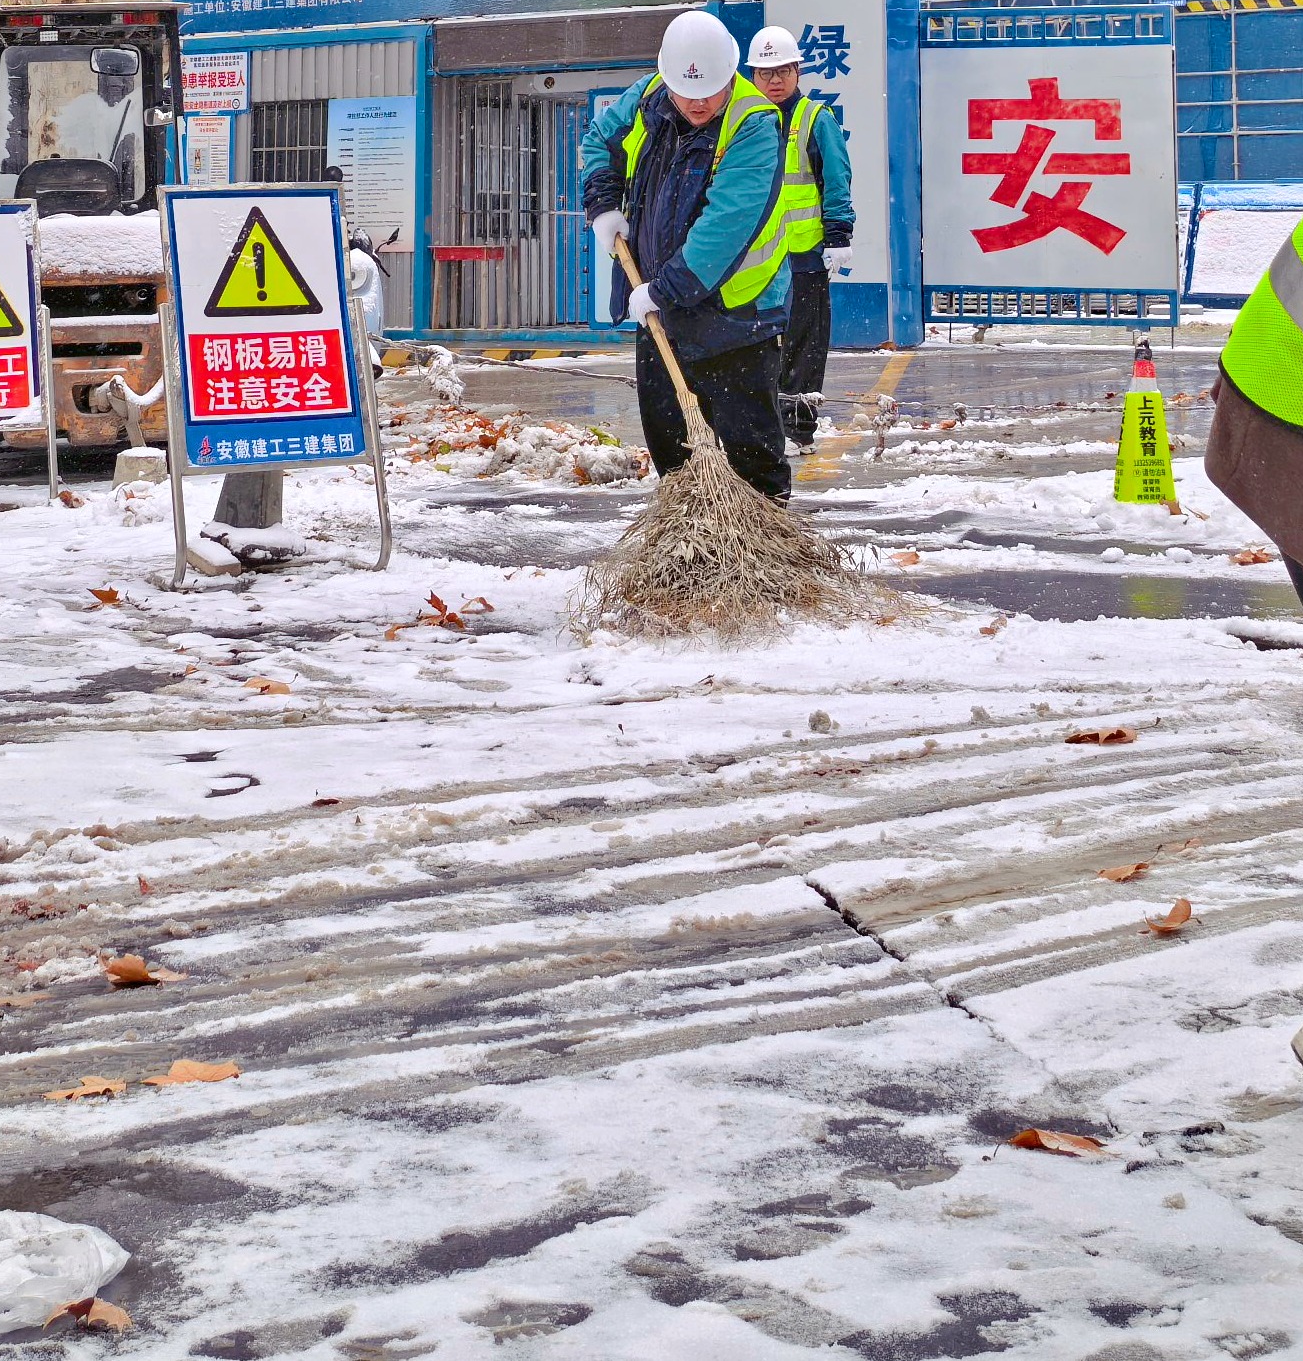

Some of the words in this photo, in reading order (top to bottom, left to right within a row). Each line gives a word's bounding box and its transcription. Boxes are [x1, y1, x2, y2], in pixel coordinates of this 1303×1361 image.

[961, 76, 1131, 256] 安
[202, 335, 327, 372] 钢板易滑
[206, 372, 333, 411] 注意安全
[1137, 395, 1157, 457] 上元教育
[216, 432, 355, 461] 安徽建工三建集团
